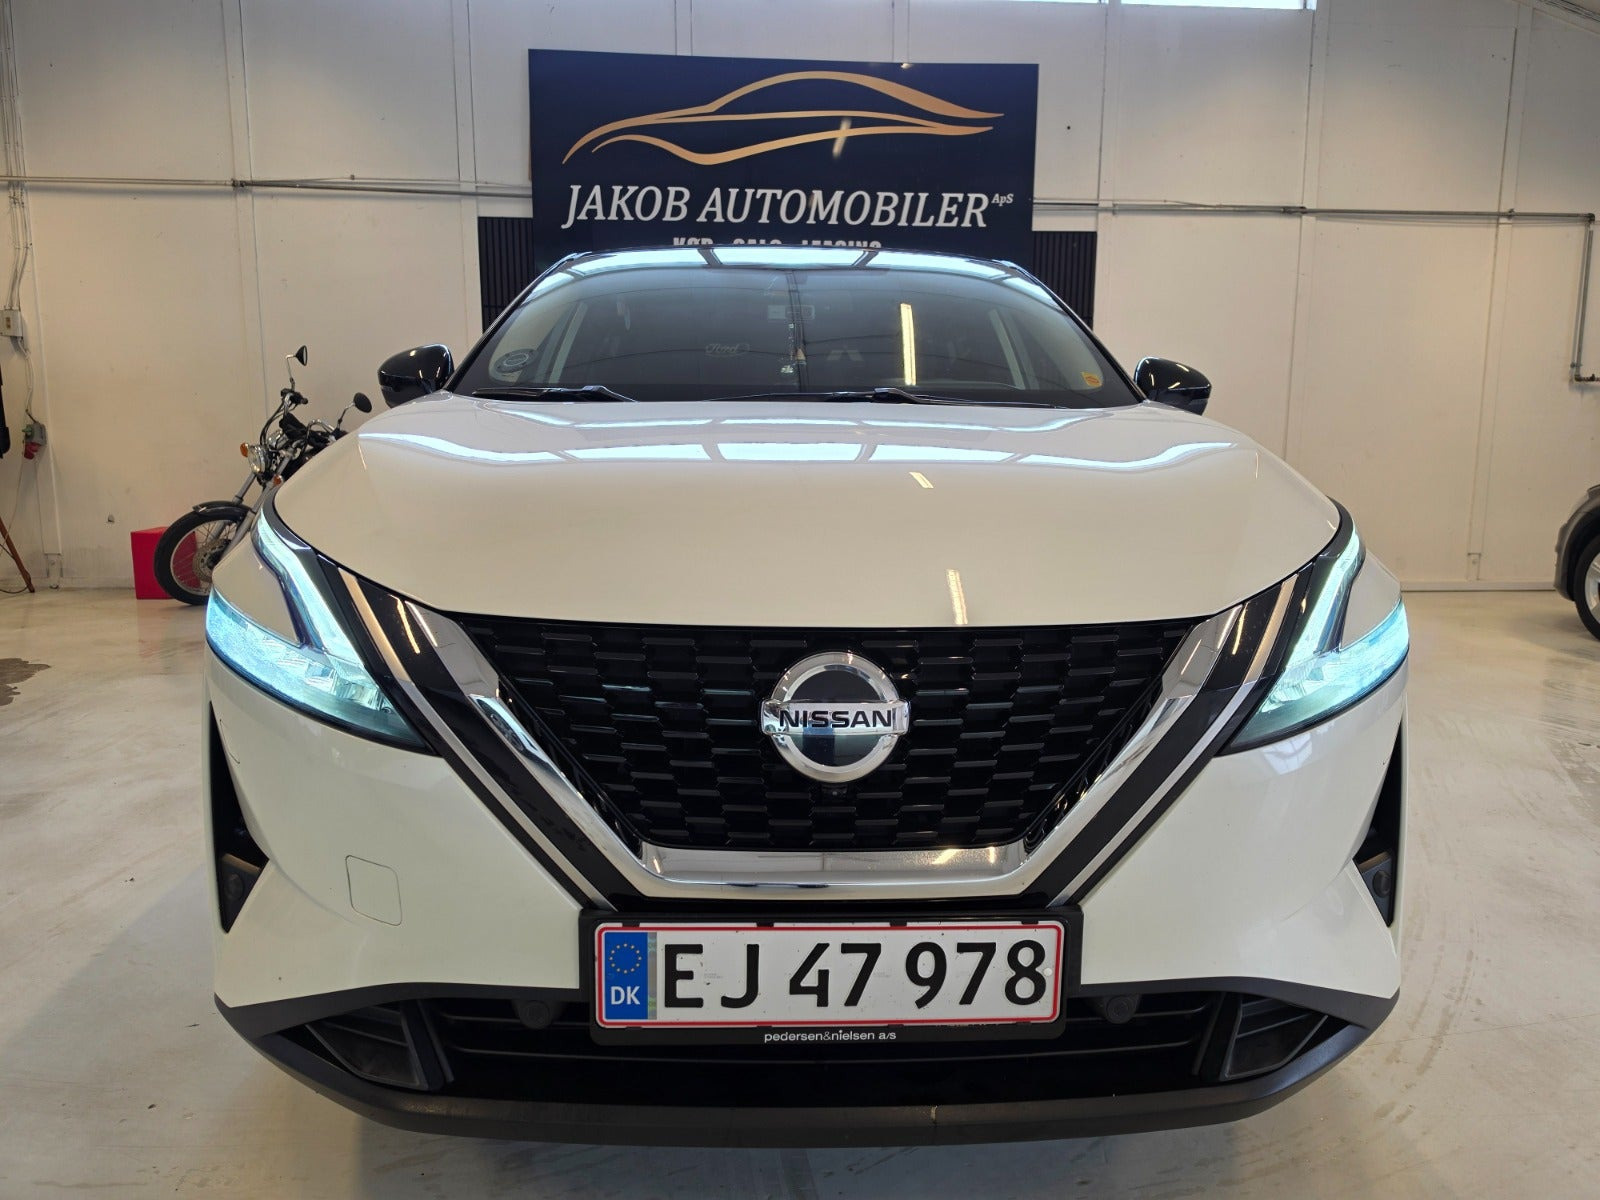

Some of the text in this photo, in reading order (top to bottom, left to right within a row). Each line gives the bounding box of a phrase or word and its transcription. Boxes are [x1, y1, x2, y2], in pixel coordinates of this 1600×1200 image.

[561, 184, 1014, 229] JAKOB AUTOMOBILER ApS
[779, 710, 892, 729] NISSAN
[664, 940, 1047, 1010] EJ 47 978
[610, 986, 641, 1006] DK
[764, 1030, 897, 1043] pedersen&nielsen a/s
